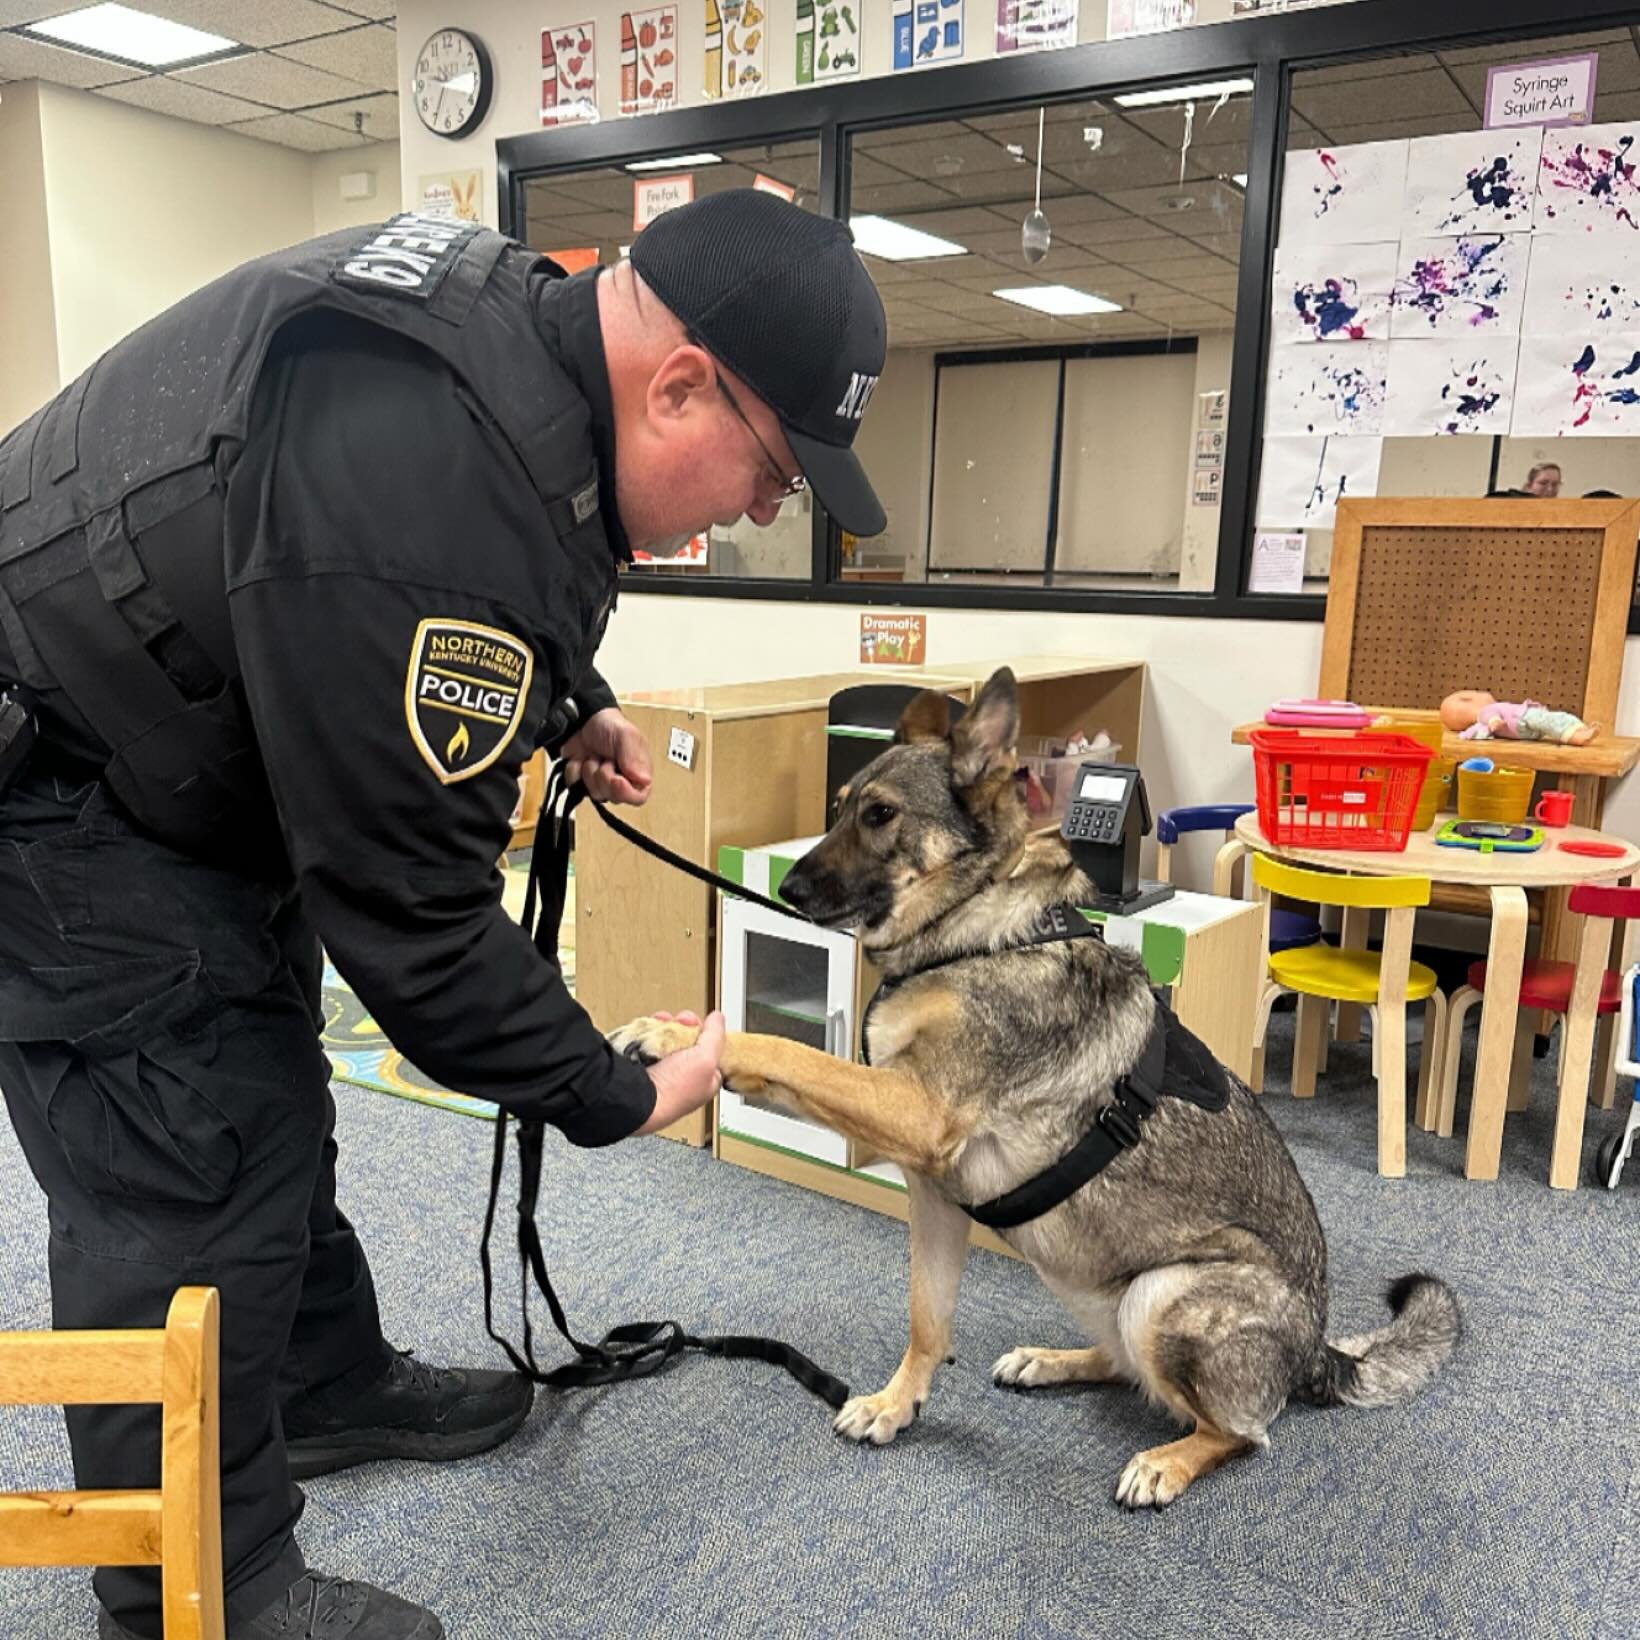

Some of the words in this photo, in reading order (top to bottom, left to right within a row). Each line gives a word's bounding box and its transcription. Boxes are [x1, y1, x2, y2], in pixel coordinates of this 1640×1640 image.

[441, 33, 453, 48] 12
[431, 42, 438, 57] 11
[420, 59, 429, 73] 10
[466, 51, 474, 66] 2
[418, 79, 424, 94] 9
[1513, 75, 1568, 96] Syringe
[422, 97, 429, 112] 8
[467, 93, 474, 106] 4
[1503, 97, 1546, 118] Squirt
[1550, 92, 1575, 110] Art
[432, 111, 438, 126] 7
[444, 114, 452, 129] 6
[458, 107, 465, 123] 5
[863, 615, 921, 631] Dramatic
[877, 630, 905, 648] Play
[429, 650, 479, 665] KENTUCKY
[431, 635, 523, 673] NORTHERN
[420, 674, 515, 717] POLICE
